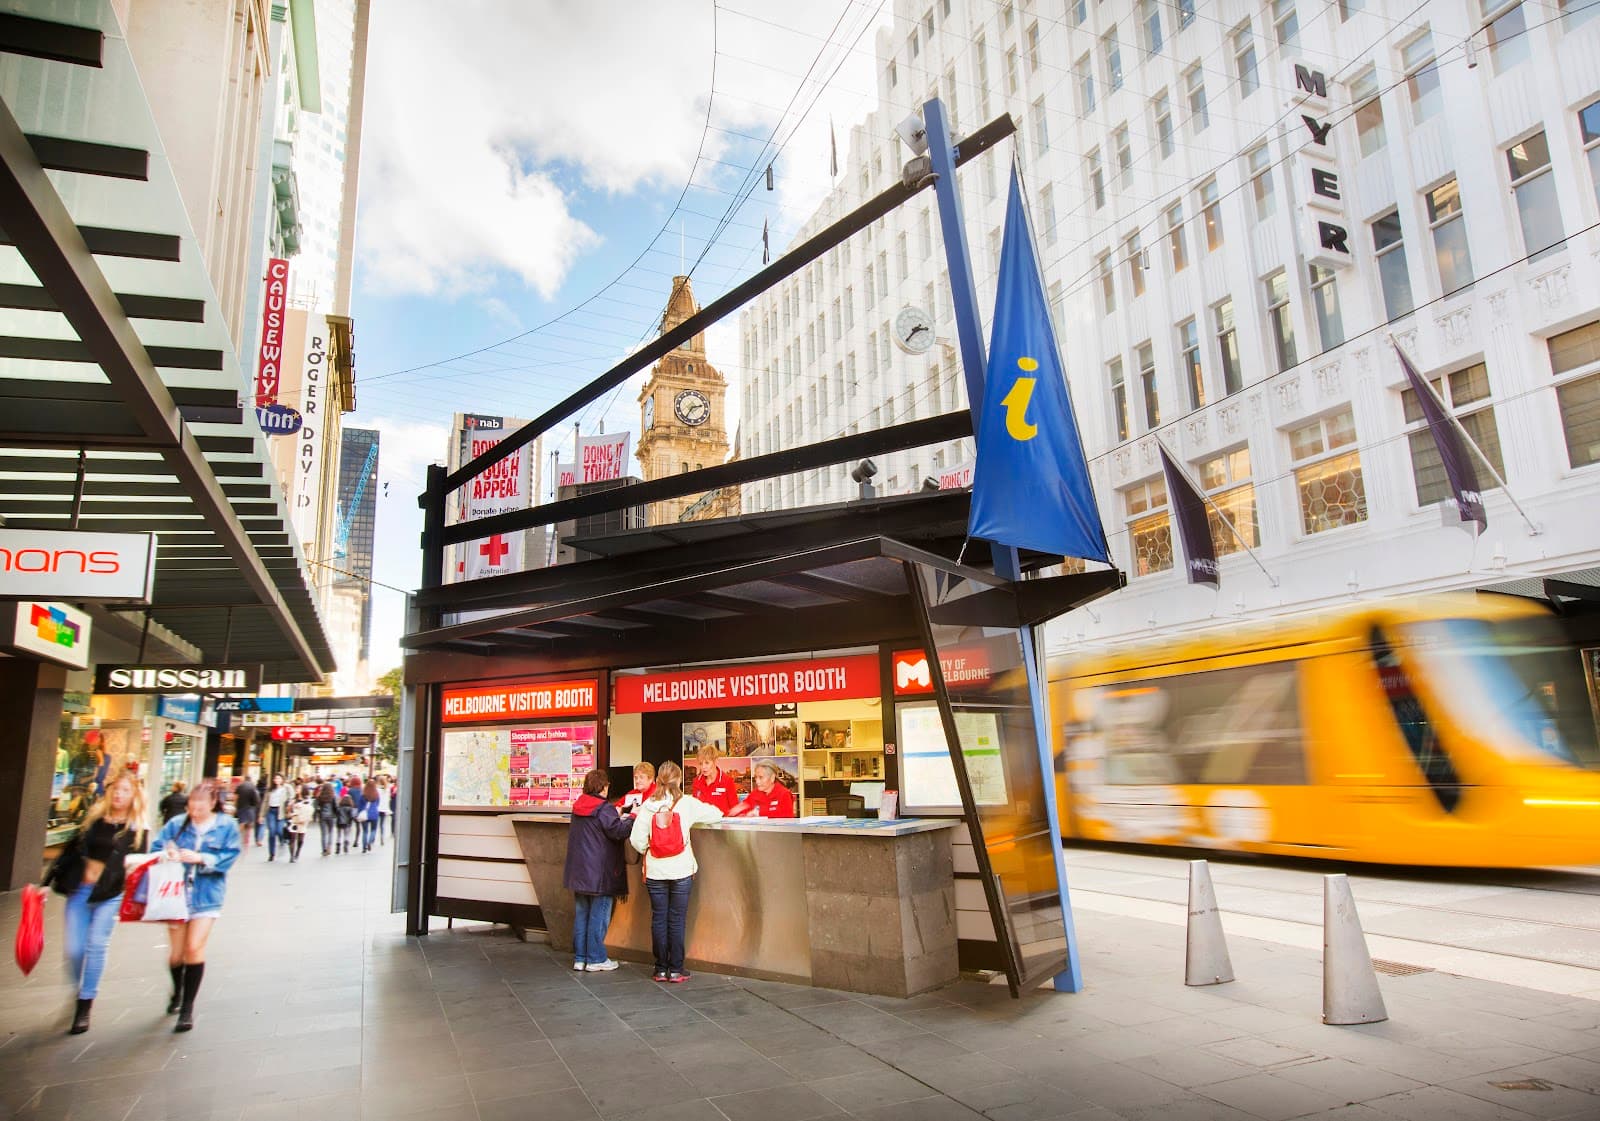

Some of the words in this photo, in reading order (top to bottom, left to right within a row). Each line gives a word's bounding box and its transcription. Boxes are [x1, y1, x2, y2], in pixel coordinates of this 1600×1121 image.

[1294, 63, 1350, 255] MYER
[262, 263, 285, 395] CAUSEWAY
[306, 336, 324, 414] ROGER
[260, 407, 294, 429] Inn
[479, 419, 500, 428] nab
[583, 444, 613, 464] DOING
[615, 442, 625, 458] IT
[474, 456, 520, 480] OUGH
[943, 667, 991, 682] ELBOURNE
[954, 659, 966, 669] OF
[109, 668, 247, 689] sussan
[643, 677, 726, 703] MELBOURNE
[729, 672, 789, 697] VISITOR
[794, 667, 847, 693] BOOTH
[445, 694, 507, 716] MELBOURNE
[509, 691, 552, 712] VISITOR
[555, 688, 593, 709] BOOTH
[511, 732, 536, 741] Shopping
